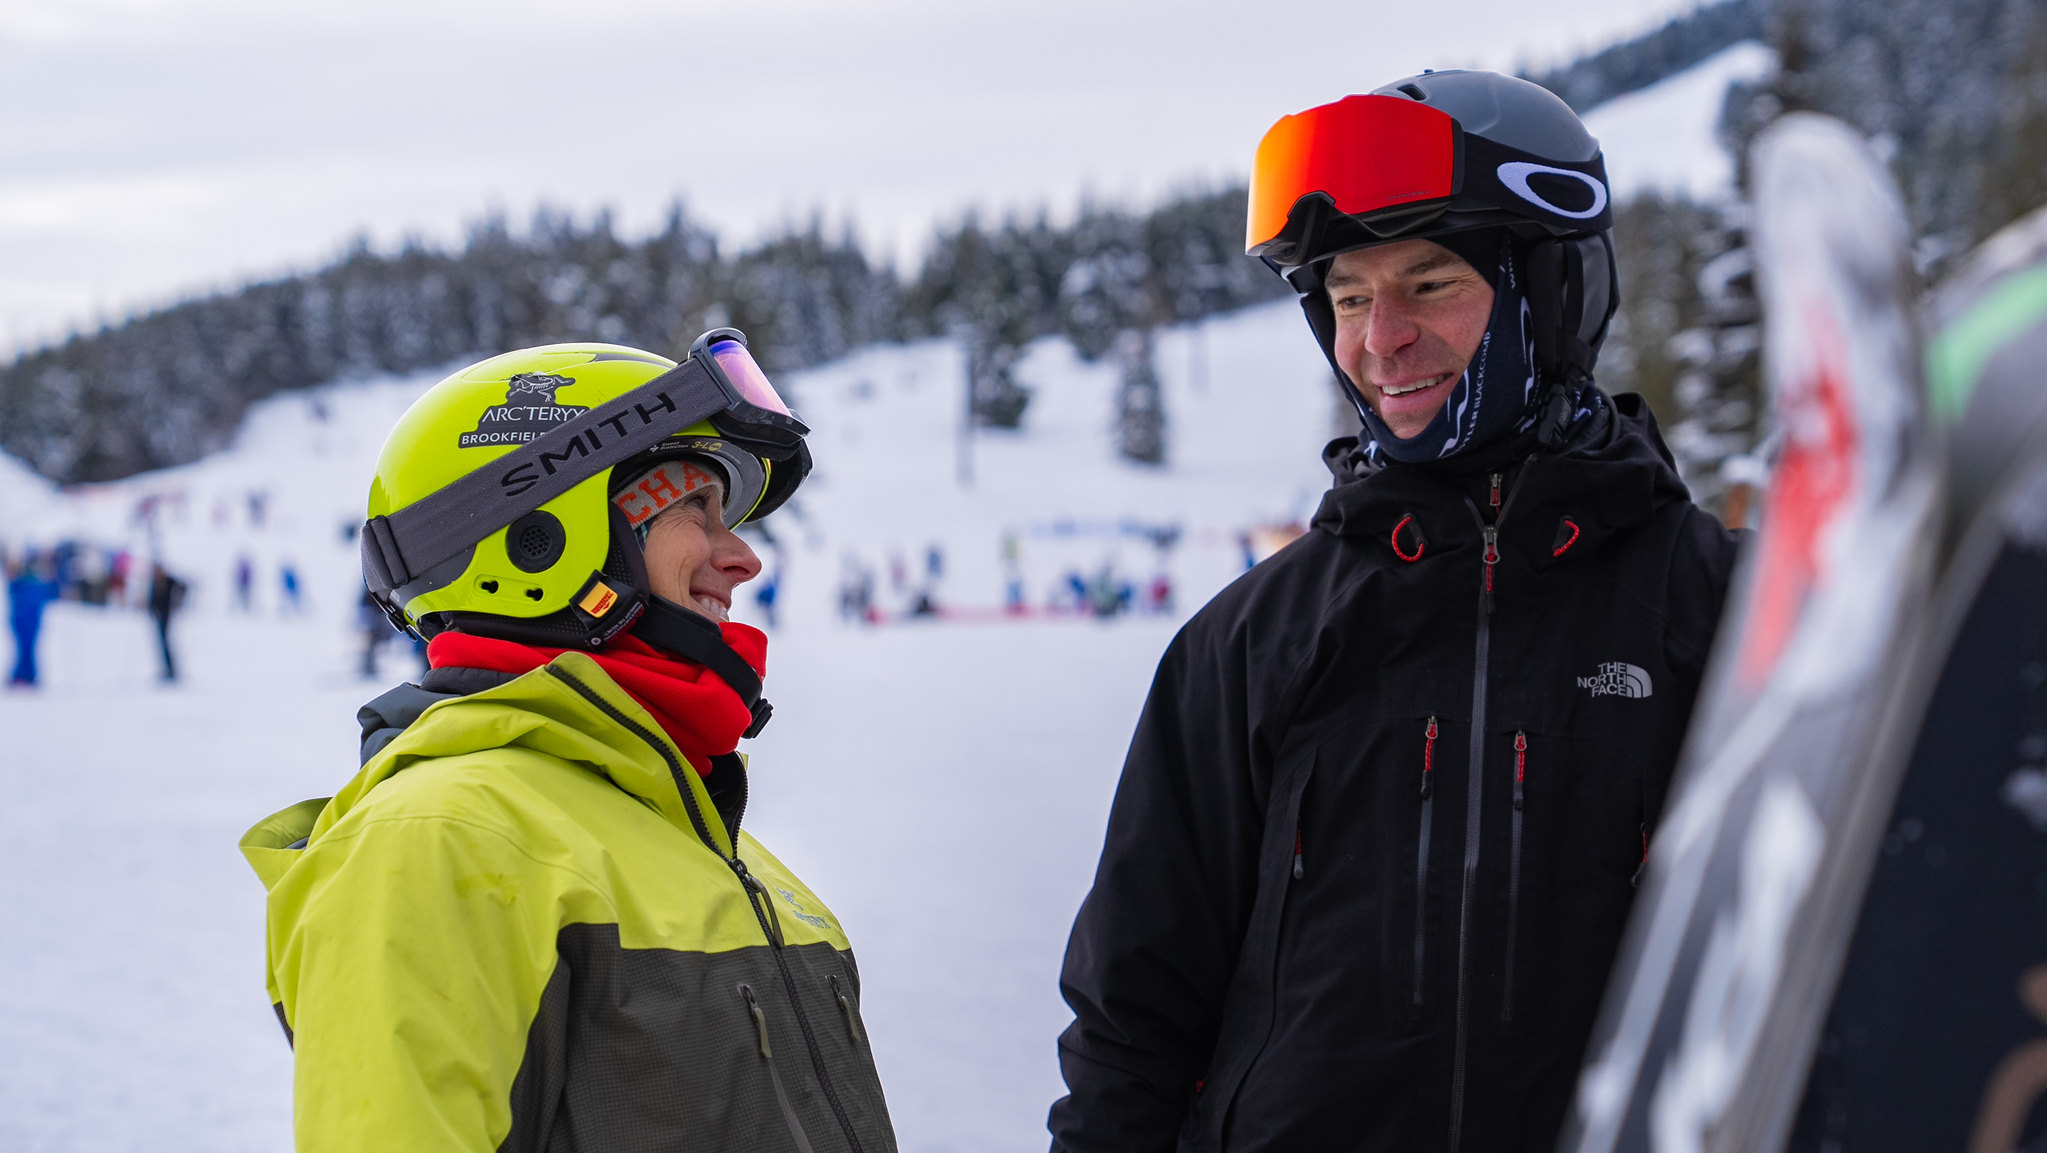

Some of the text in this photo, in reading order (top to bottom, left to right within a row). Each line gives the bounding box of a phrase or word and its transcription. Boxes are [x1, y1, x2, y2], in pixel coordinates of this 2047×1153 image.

[501, 392, 677, 497] SMITH
[1598, 661, 1627, 674] THE
[1577, 672, 1627, 689] NORTH
[1591, 684, 1627, 698] FACE
